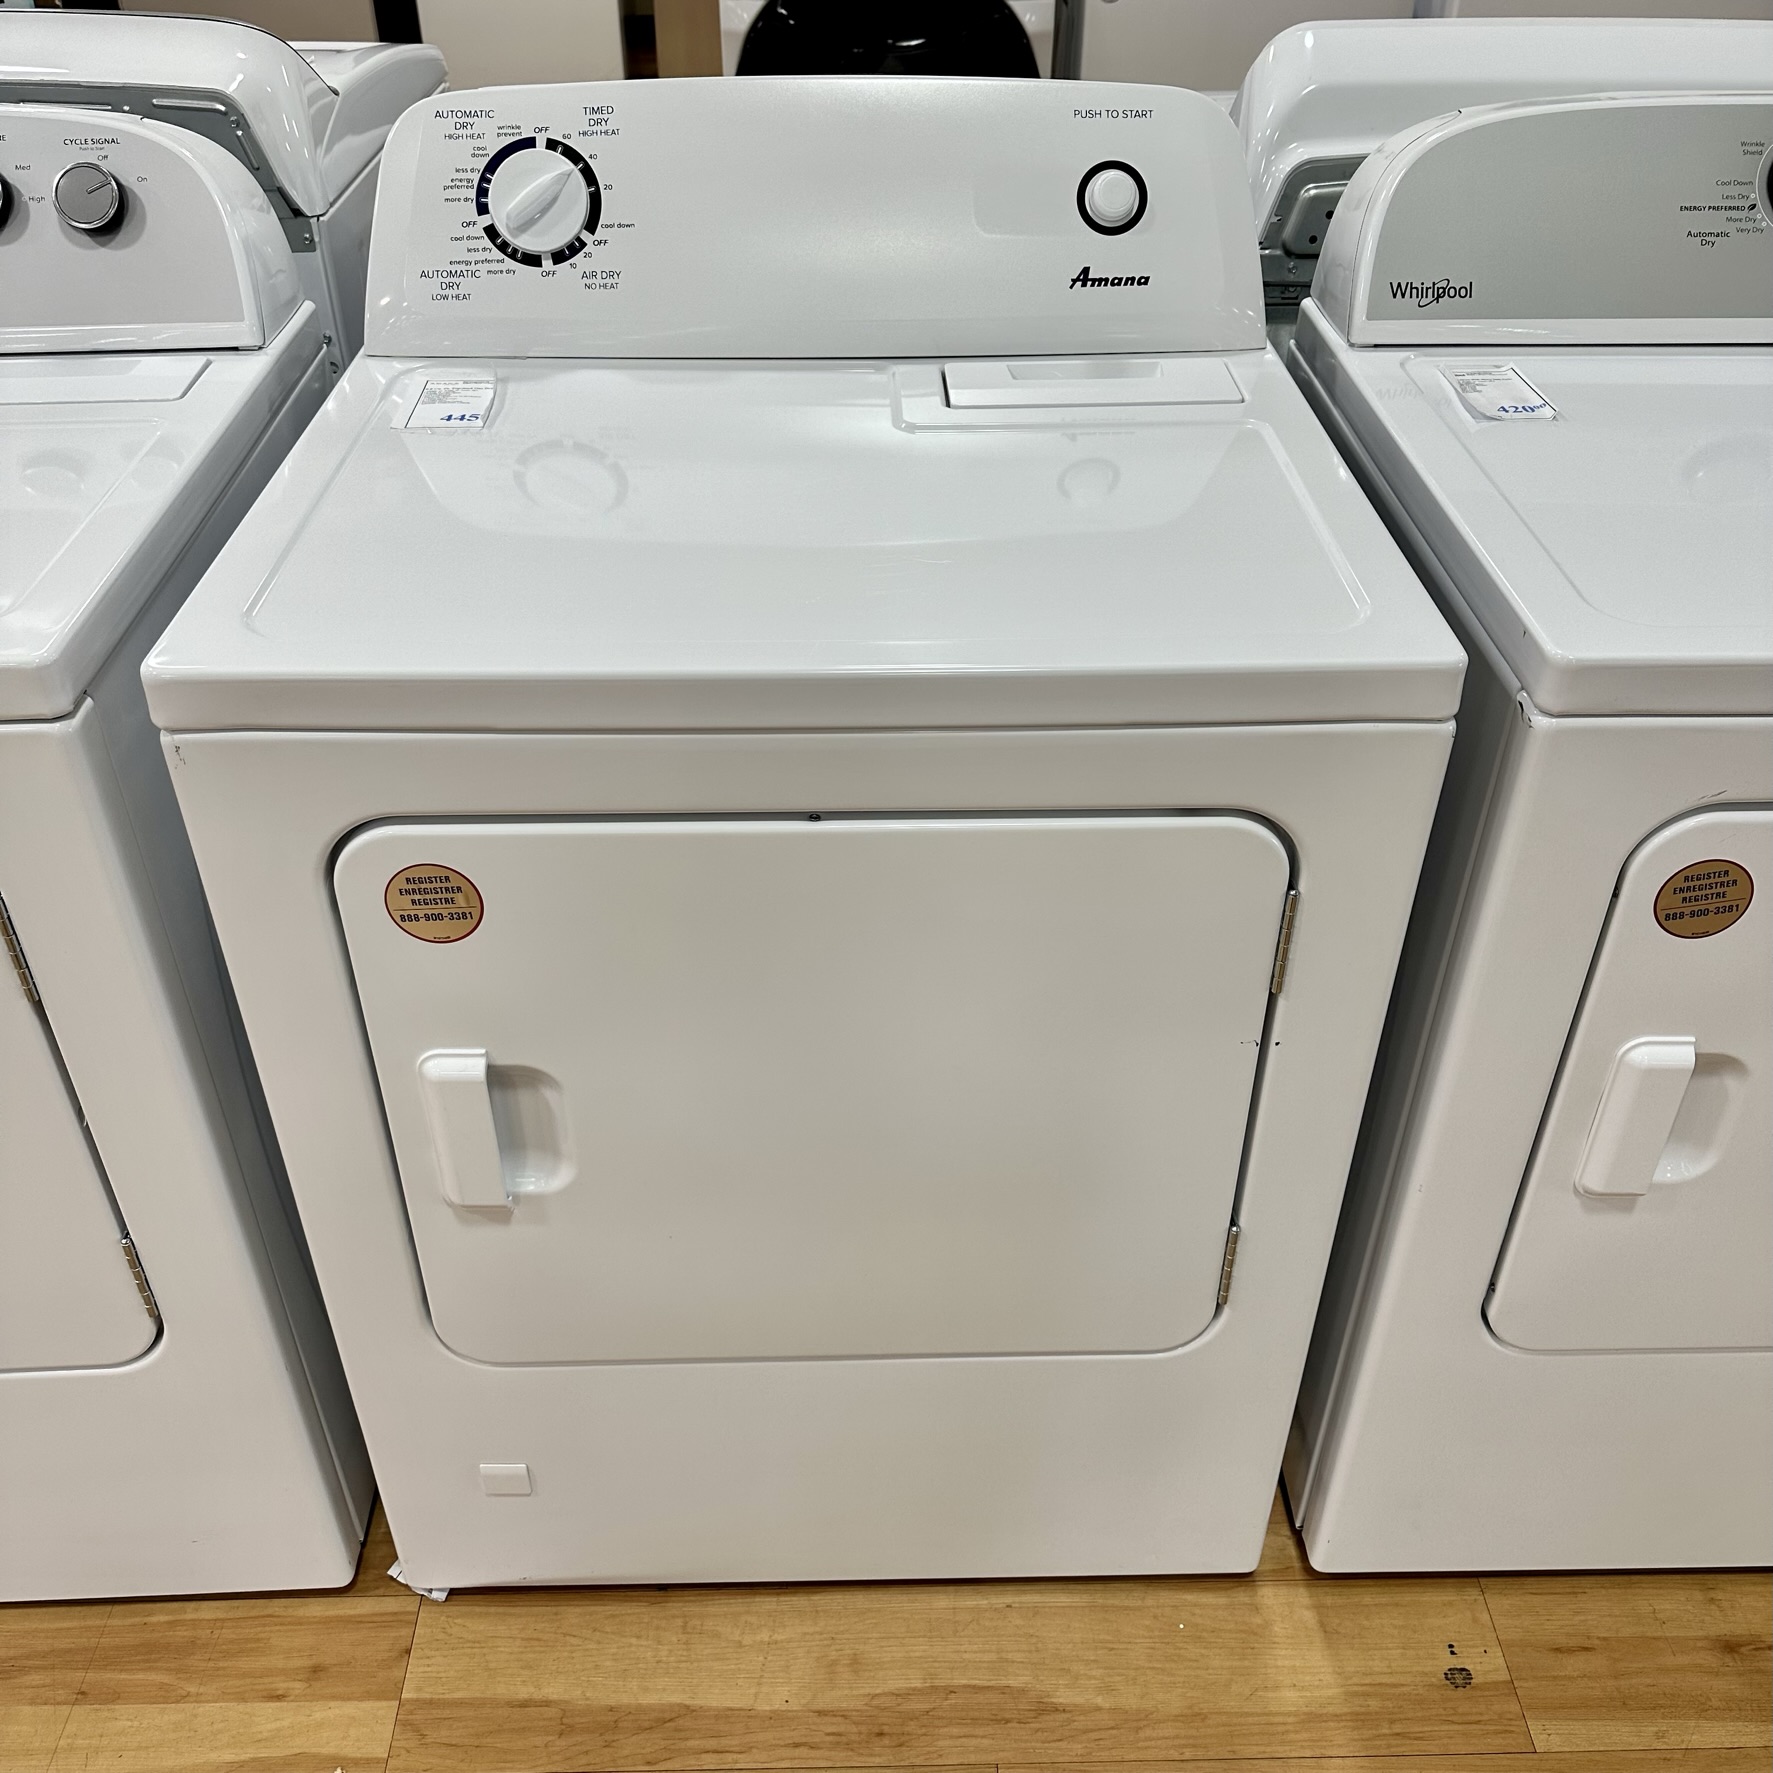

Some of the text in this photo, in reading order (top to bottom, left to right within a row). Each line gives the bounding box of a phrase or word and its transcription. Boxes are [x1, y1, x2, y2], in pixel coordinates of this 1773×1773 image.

[434, 110, 494, 119] AUTOMATIC
[583, 106, 614, 115] TIMED
[1074, 110, 1154, 118] PUSH TO START
[454, 122, 475, 130] DRY
[588, 118, 610, 127] DRY
[1701, 239, 1716, 247] Dry
[420, 270, 481, 279] AUTOMATIC
[581, 271, 622, 280] AIR DRY
[1069, 266, 1150, 290] Amana
[440, 282, 461, 290] DRY
[1390, 278, 1473, 308] Whirlpool
[440, 414, 480, 422] 445
[405, 876, 451, 885] REGISTER
[1684, 870, 1729, 883] REGISTER
[399, 886, 463, 896] ENREGISTRER
[1673, 879, 1738, 895] ENREGISTRER
[411, 897, 456, 906] REGISTRE
[1681, 891, 1727, 904] REGISTRE
[400, 912, 473, 922] 888-900-3381
[1664, 904, 1739, 921] 888-900-3381
